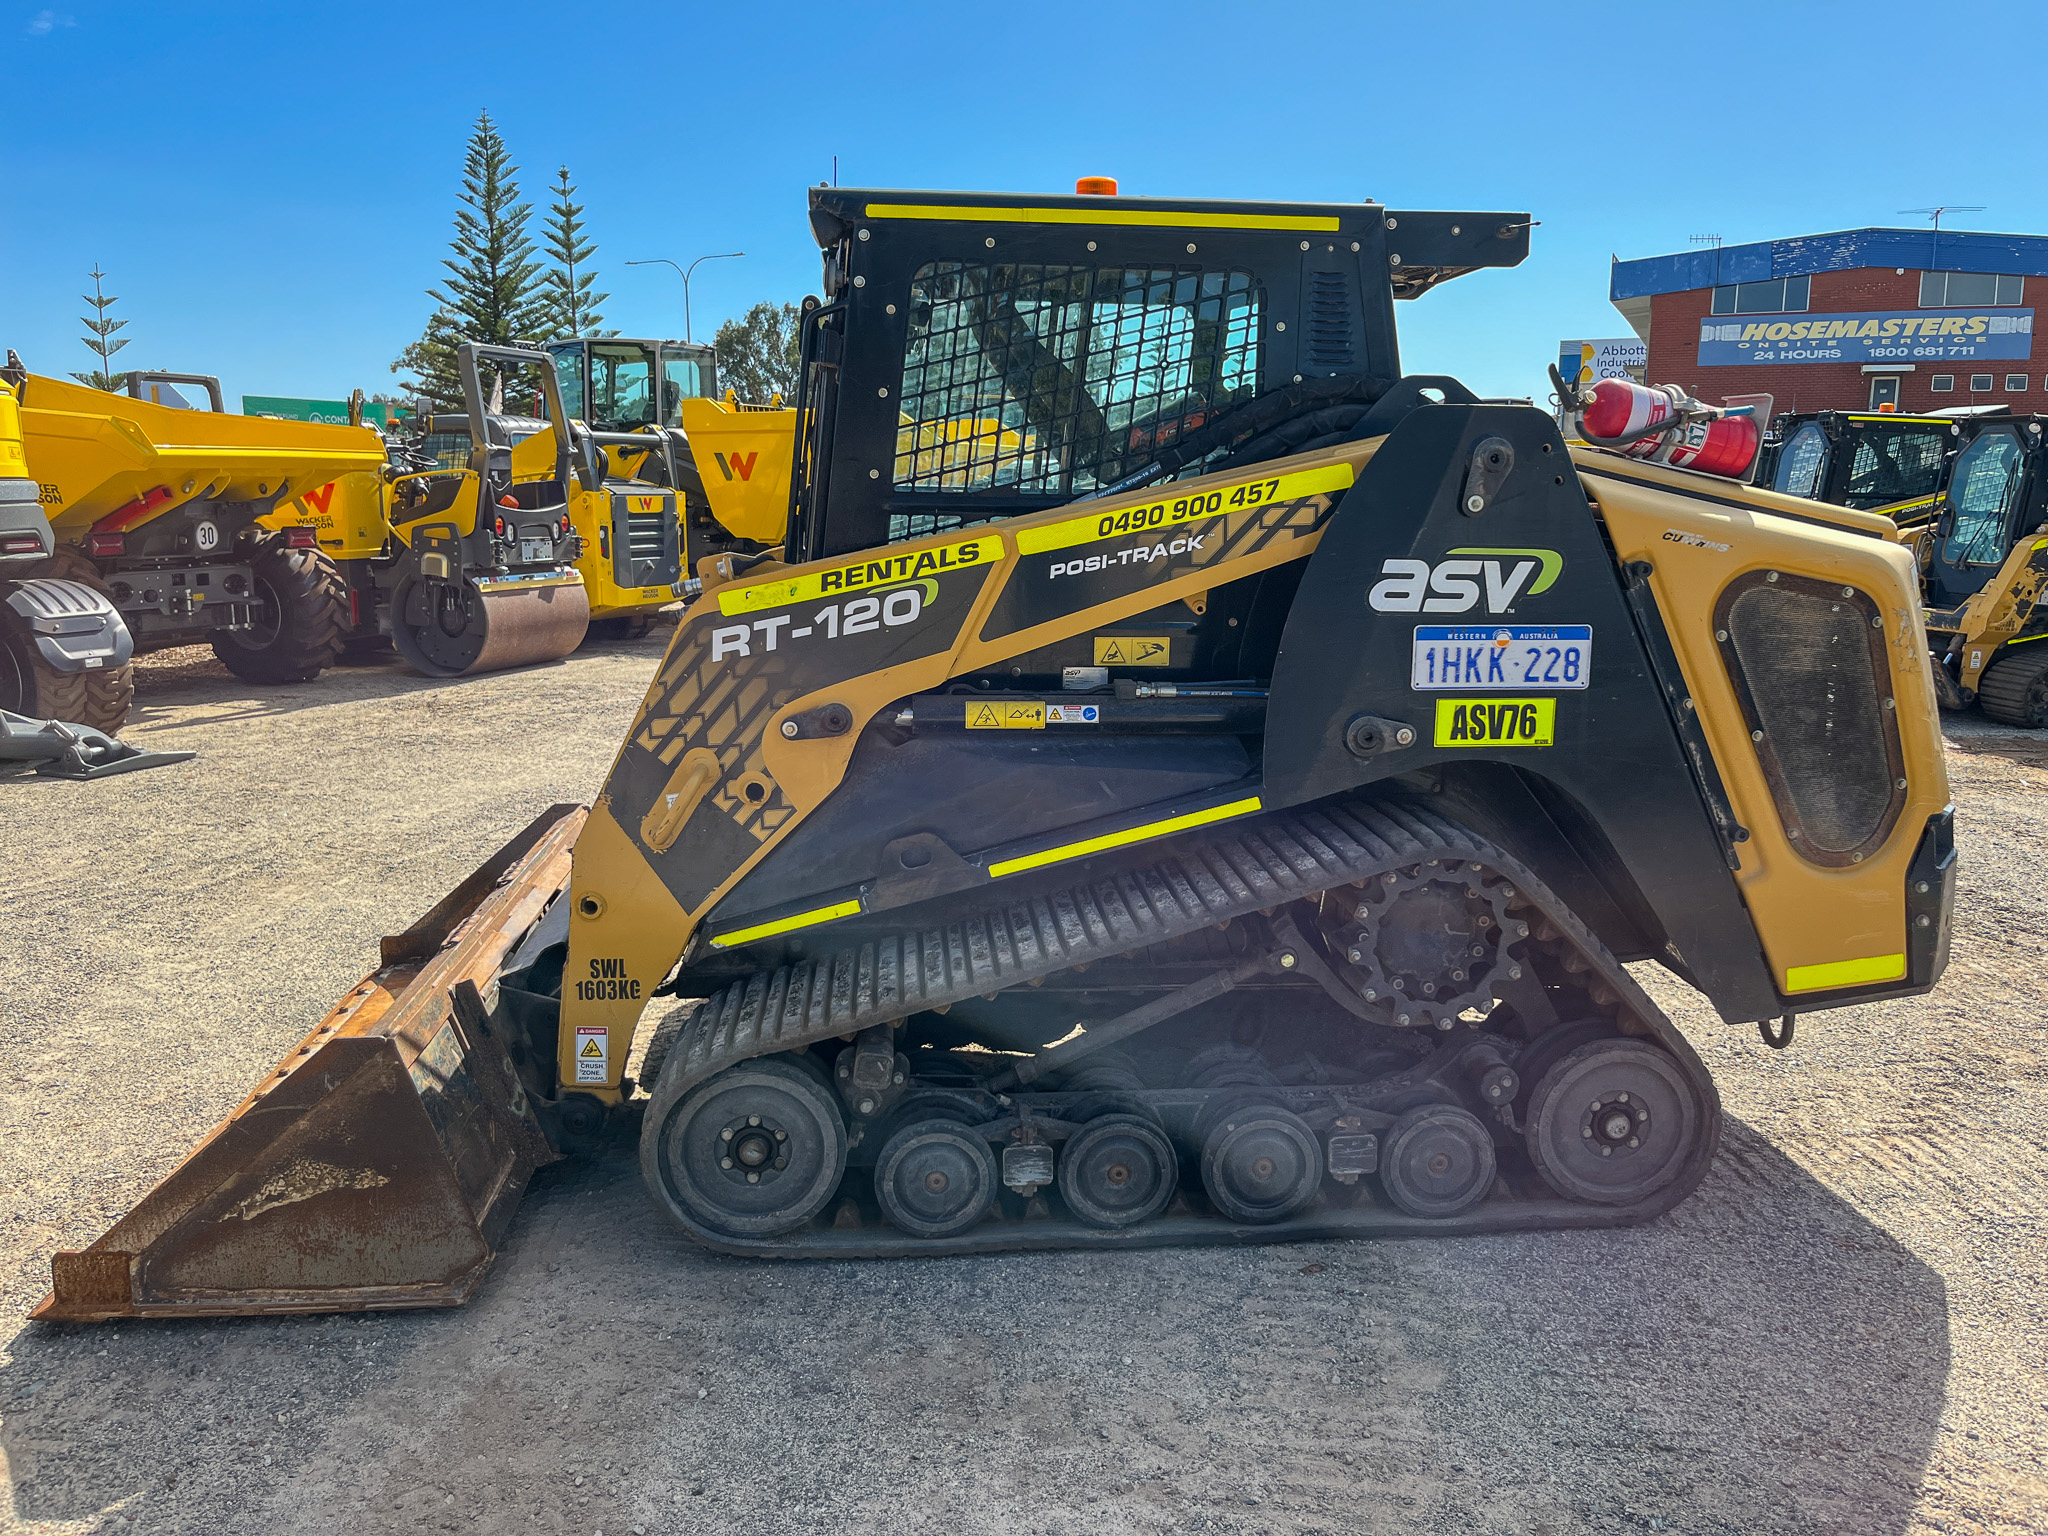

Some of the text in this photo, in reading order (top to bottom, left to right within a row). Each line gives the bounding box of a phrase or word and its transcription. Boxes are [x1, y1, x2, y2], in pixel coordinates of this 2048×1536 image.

[1740, 316, 1990, 341] HOSEMASTERS
[1737, 336, 1987, 349] ONSITE SERVICE
[1753, 346, 1975, 360] 24 HOURS 1800 681 711
[1597, 357, 1647, 368] Industria
[200, 527, 214, 545] 30
[820, 479, 1280, 592] RENTALS 0490 900 457
[1049, 534, 1205, 580] POSI-TRACK
[712, 589, 921, 663] RT-120
[1449, 704, 1537, 740] ASV76
[589, 958, 627, 979] SWL
[575, 979, 641, 1001] 1603KG
